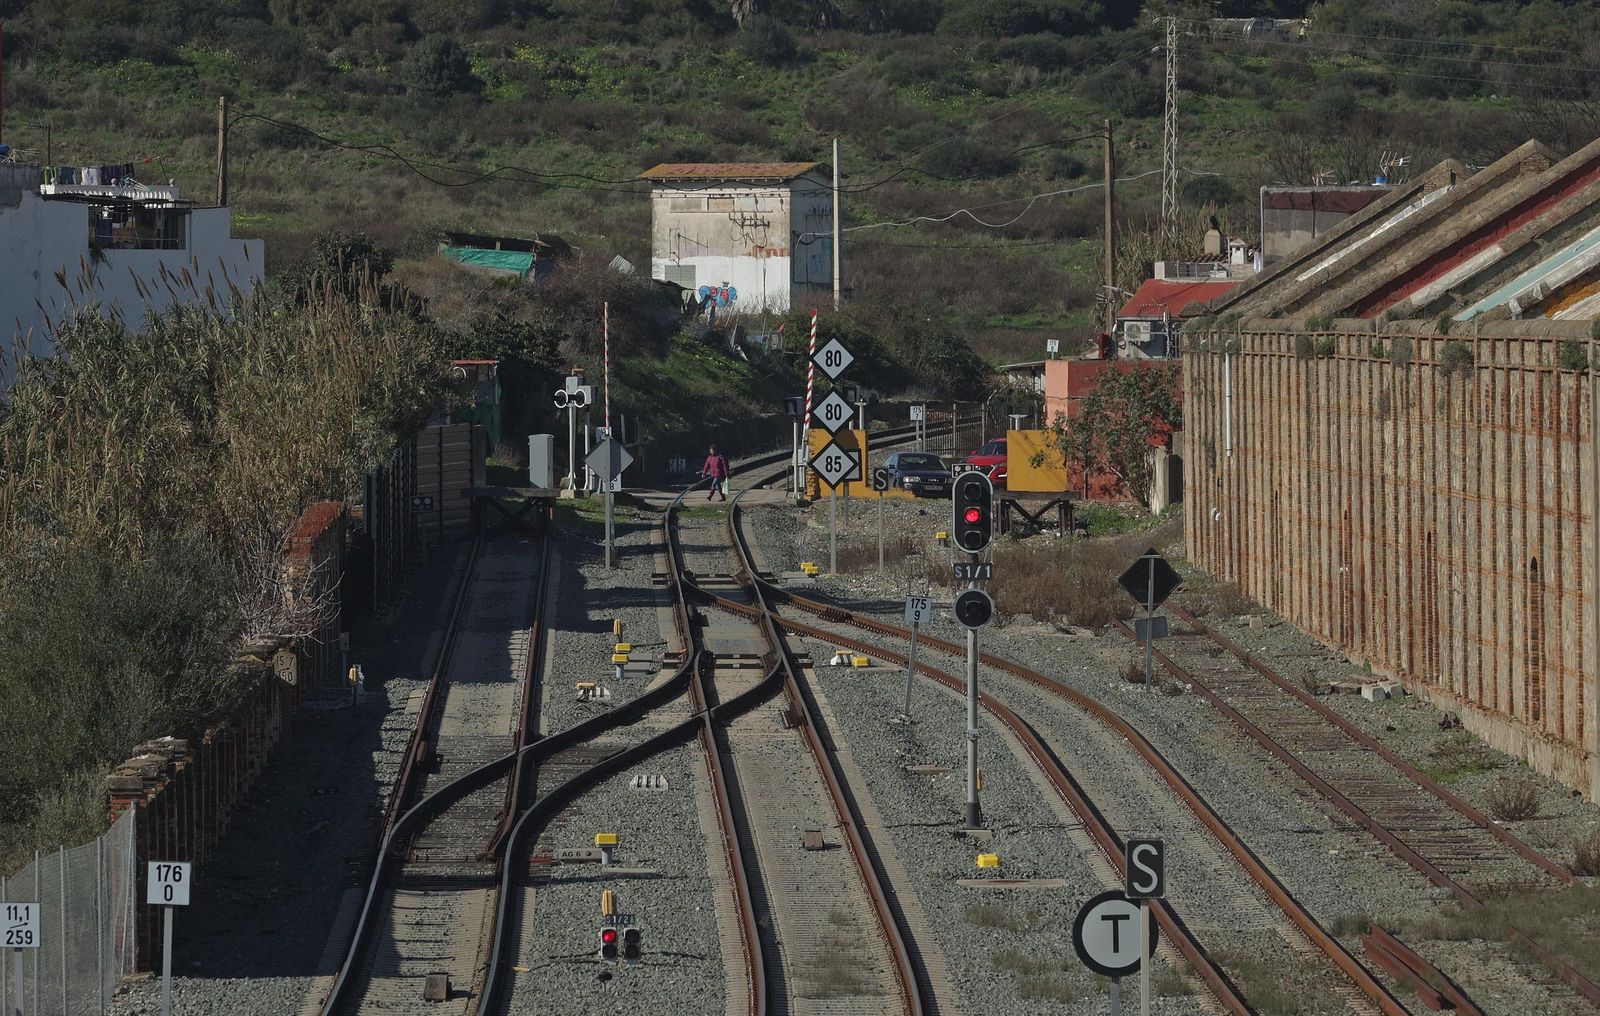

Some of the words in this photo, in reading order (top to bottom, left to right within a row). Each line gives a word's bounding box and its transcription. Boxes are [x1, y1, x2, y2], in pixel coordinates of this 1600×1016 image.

[825, 350, 842, 367] 80
[825, 403, 842, 420] 80
[825, 456, 842, 472] 85
[875, 469, 887, 490] S
[911, 598, 926, 609] 175
[914, 610, 920, 620] 9
[156, 864, 182, 883] 176
[1132, 843, 1159, 894] S
[164, 884, 173, 902] 0
[6, 905, 30, 921] 11,1
[6, 930, 33, 945] 259
[1101, 914, 1130, 953] T
